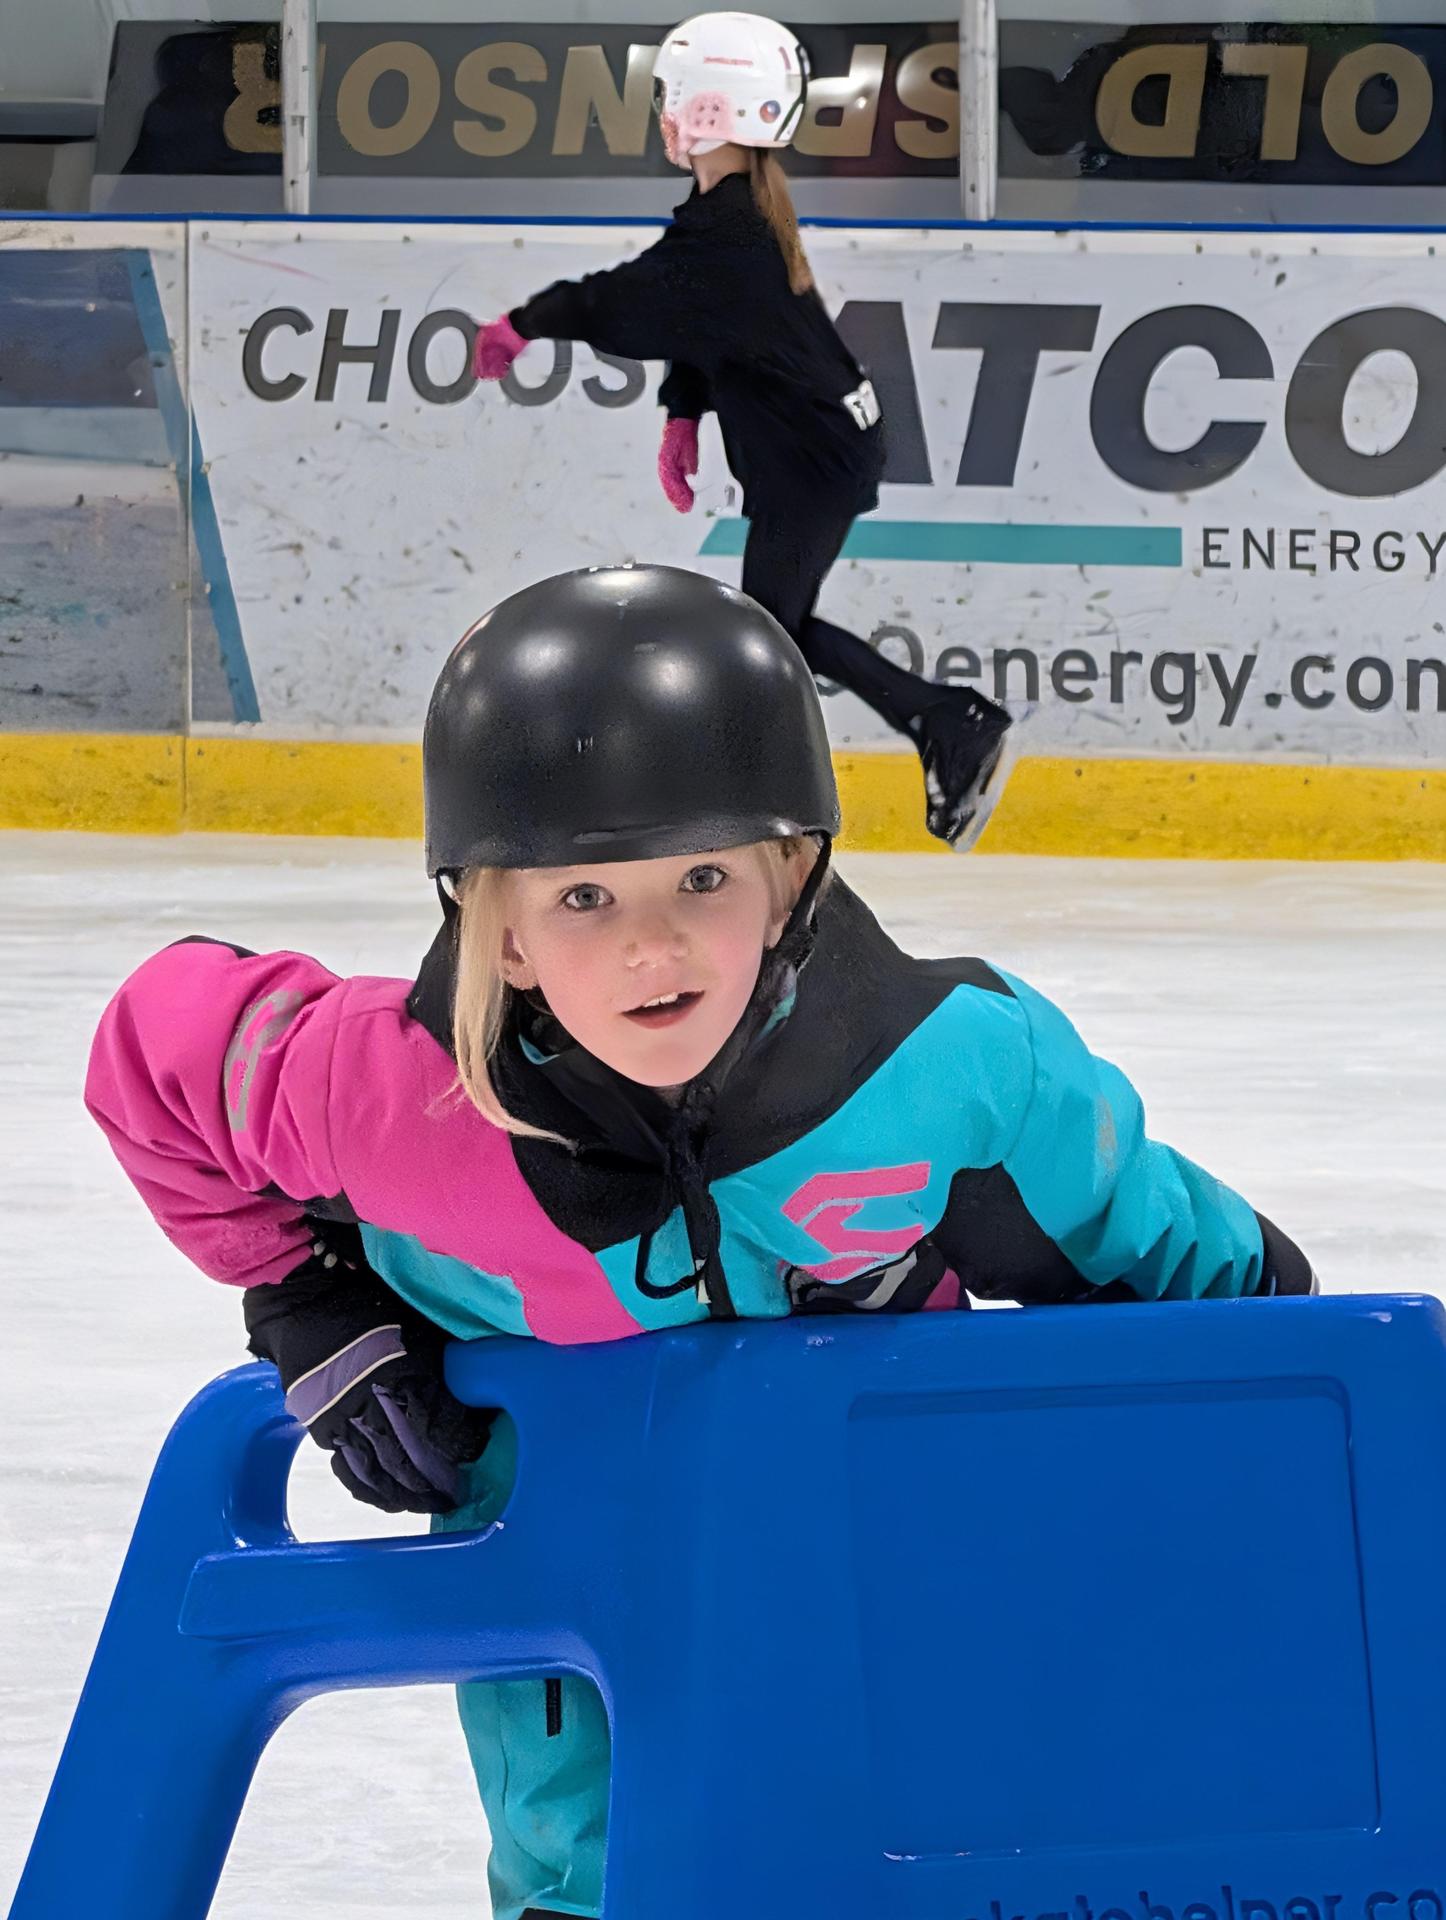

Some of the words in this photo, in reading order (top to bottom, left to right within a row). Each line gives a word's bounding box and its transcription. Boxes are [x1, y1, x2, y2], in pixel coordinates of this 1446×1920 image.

[223, 41, 960, 157] SPNSOR
[242, 306, 673, 408] CHOOS
[1202, 528, 1446, 573] ENERGY
